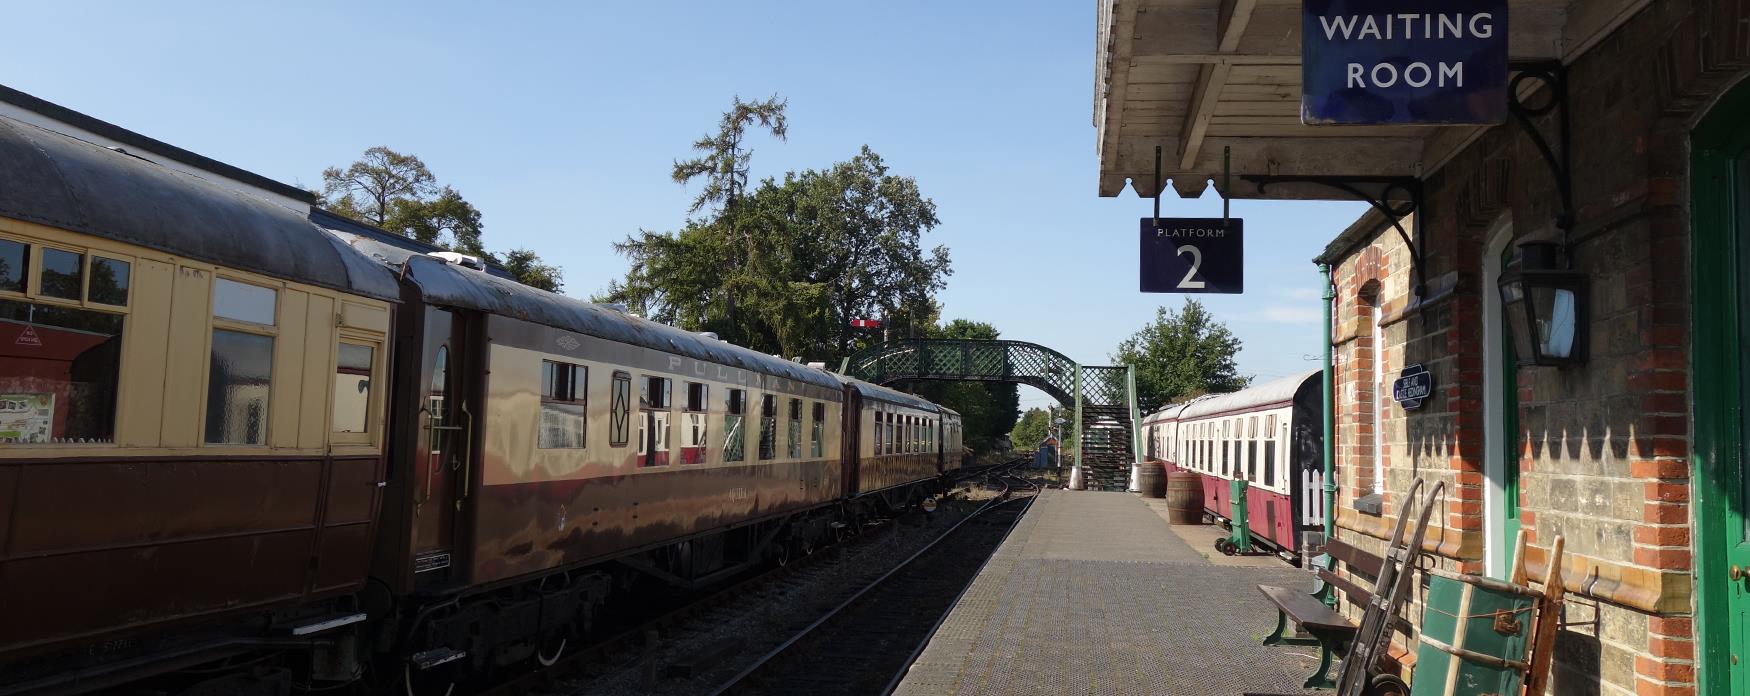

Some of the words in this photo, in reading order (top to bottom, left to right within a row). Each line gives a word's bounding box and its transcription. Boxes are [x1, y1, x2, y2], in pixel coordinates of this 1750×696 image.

[1319, 12, 1493, 40] WAITING
[1347, 61, 1463, 89] ROOM
[1157, 228, 1225, 238] PLATFORM
[1176, 244, 1206, 289] 2
